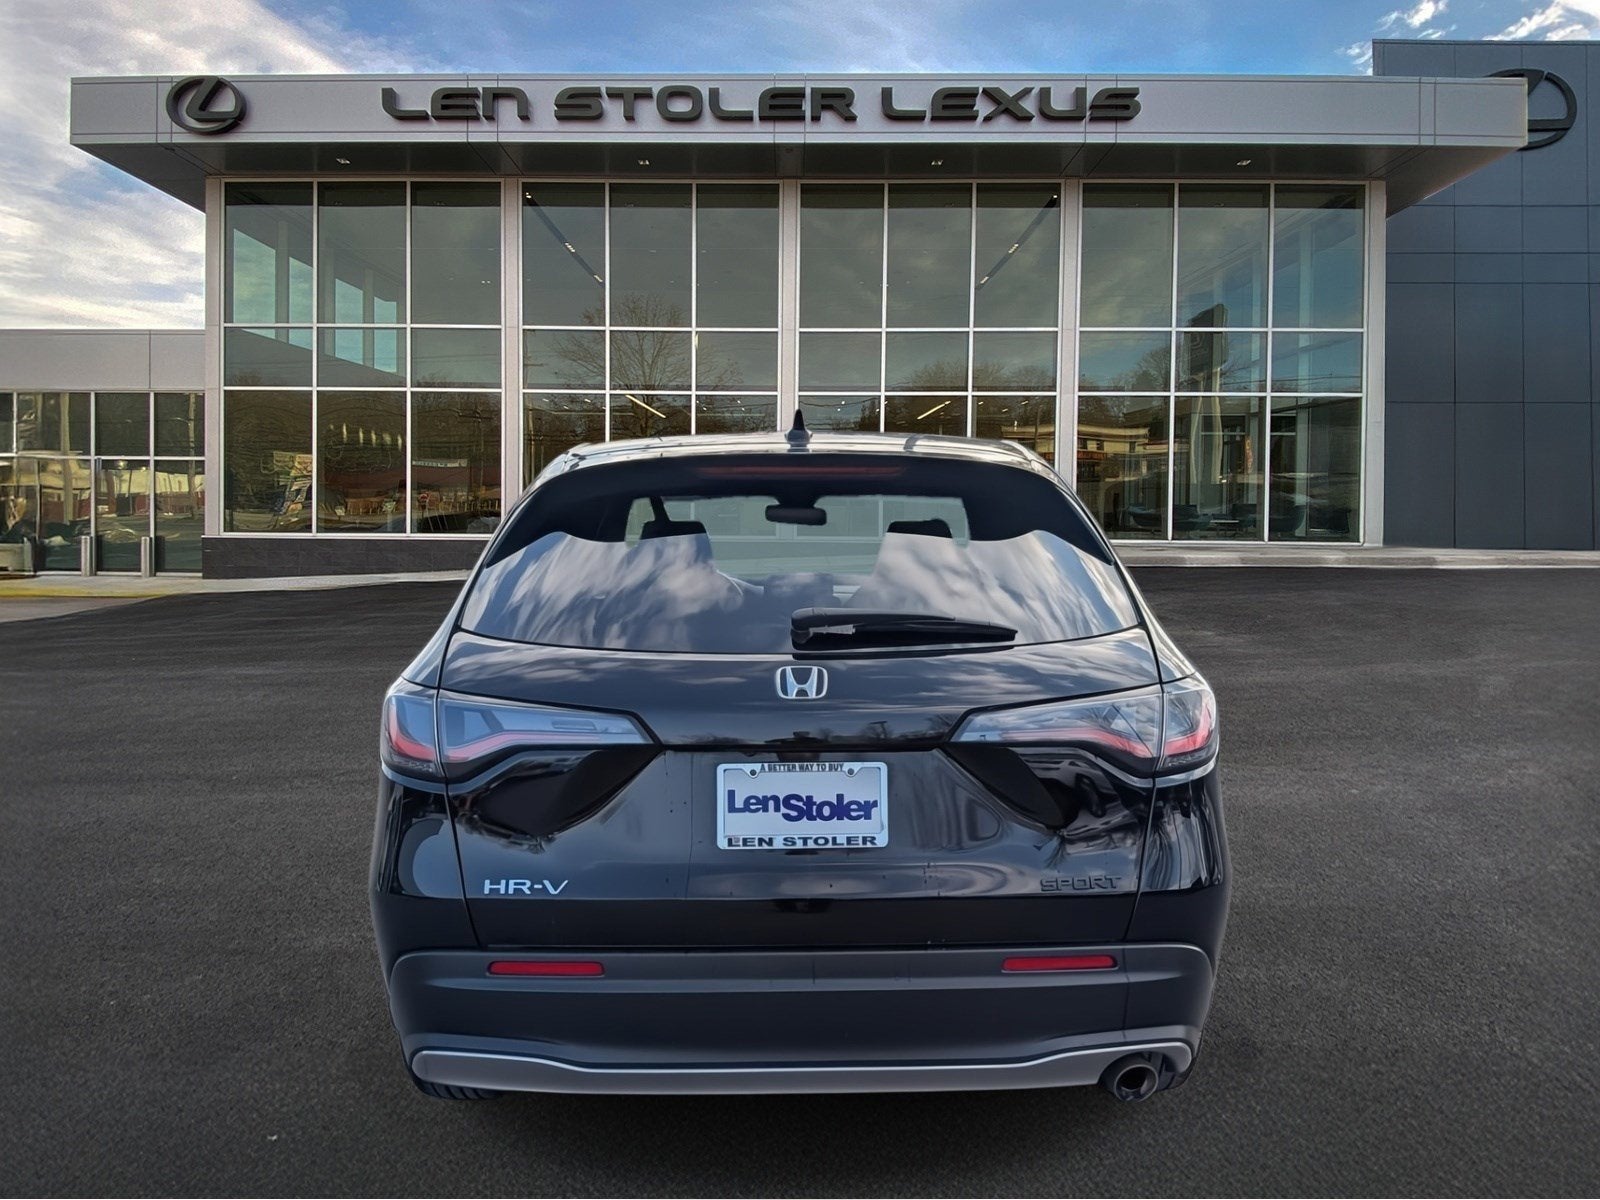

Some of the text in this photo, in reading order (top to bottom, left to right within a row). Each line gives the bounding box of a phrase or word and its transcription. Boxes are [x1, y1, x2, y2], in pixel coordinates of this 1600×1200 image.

[381, 85, 1142, 121] LEN STOLER LEXUS
[760, 763, 845, 772] A BETTER WAY TO BUY
[727, 836, 878, 848] LEN STOLER
[483, 879, 569, 895] HR-V
[1040, 875, 1122, 892] SPORT
